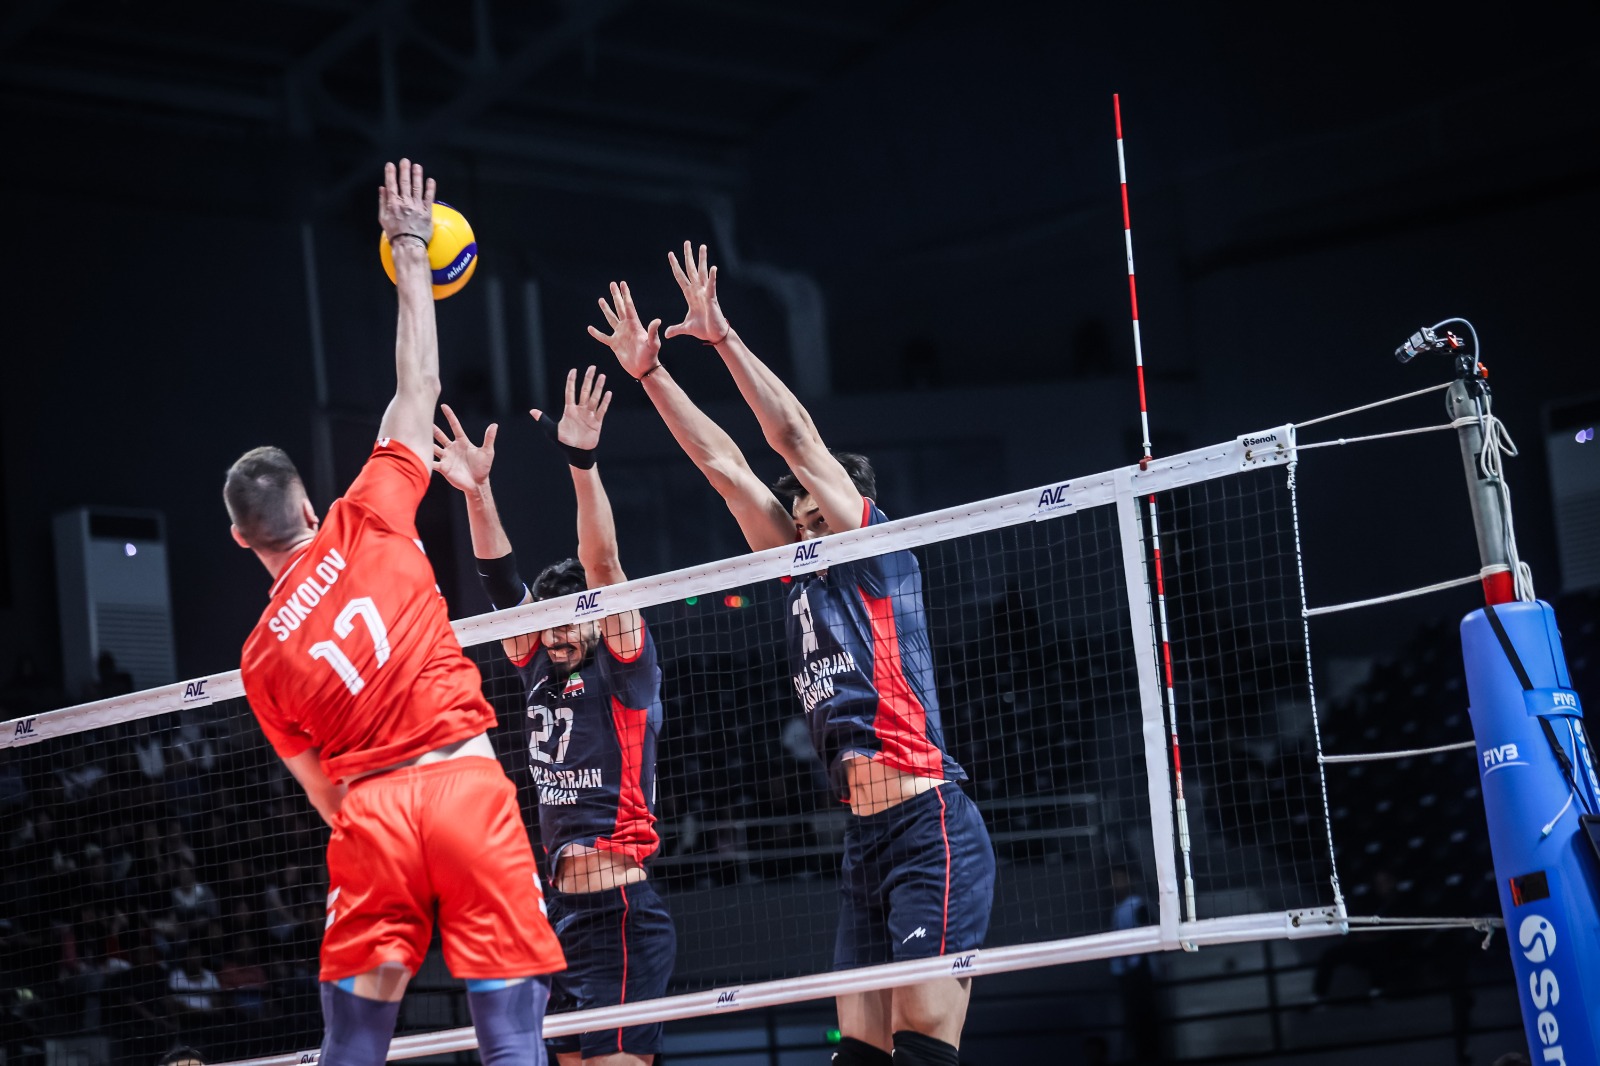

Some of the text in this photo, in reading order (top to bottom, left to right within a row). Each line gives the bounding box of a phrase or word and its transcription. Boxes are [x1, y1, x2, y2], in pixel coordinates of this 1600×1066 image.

[1249, 434, 1277, 446] Senoh
[1038, 484, 1070, 508] AVC
[793, 540, 823, 563] AVC
[268, 547, 347, 642] SOKOLOV
[575, 591, 602, 612] AVC
[308, 596, 391, 696] 17
[810, 651, 856, 681] SIRJAN
[183, 680, 208, 699] AVC
[15, 717, 37, 736] AVC
[527, 704, 574, 765] 27
[556, 768, 603, 789] SIRJAN
[952, 954, 976, 970] AVC
